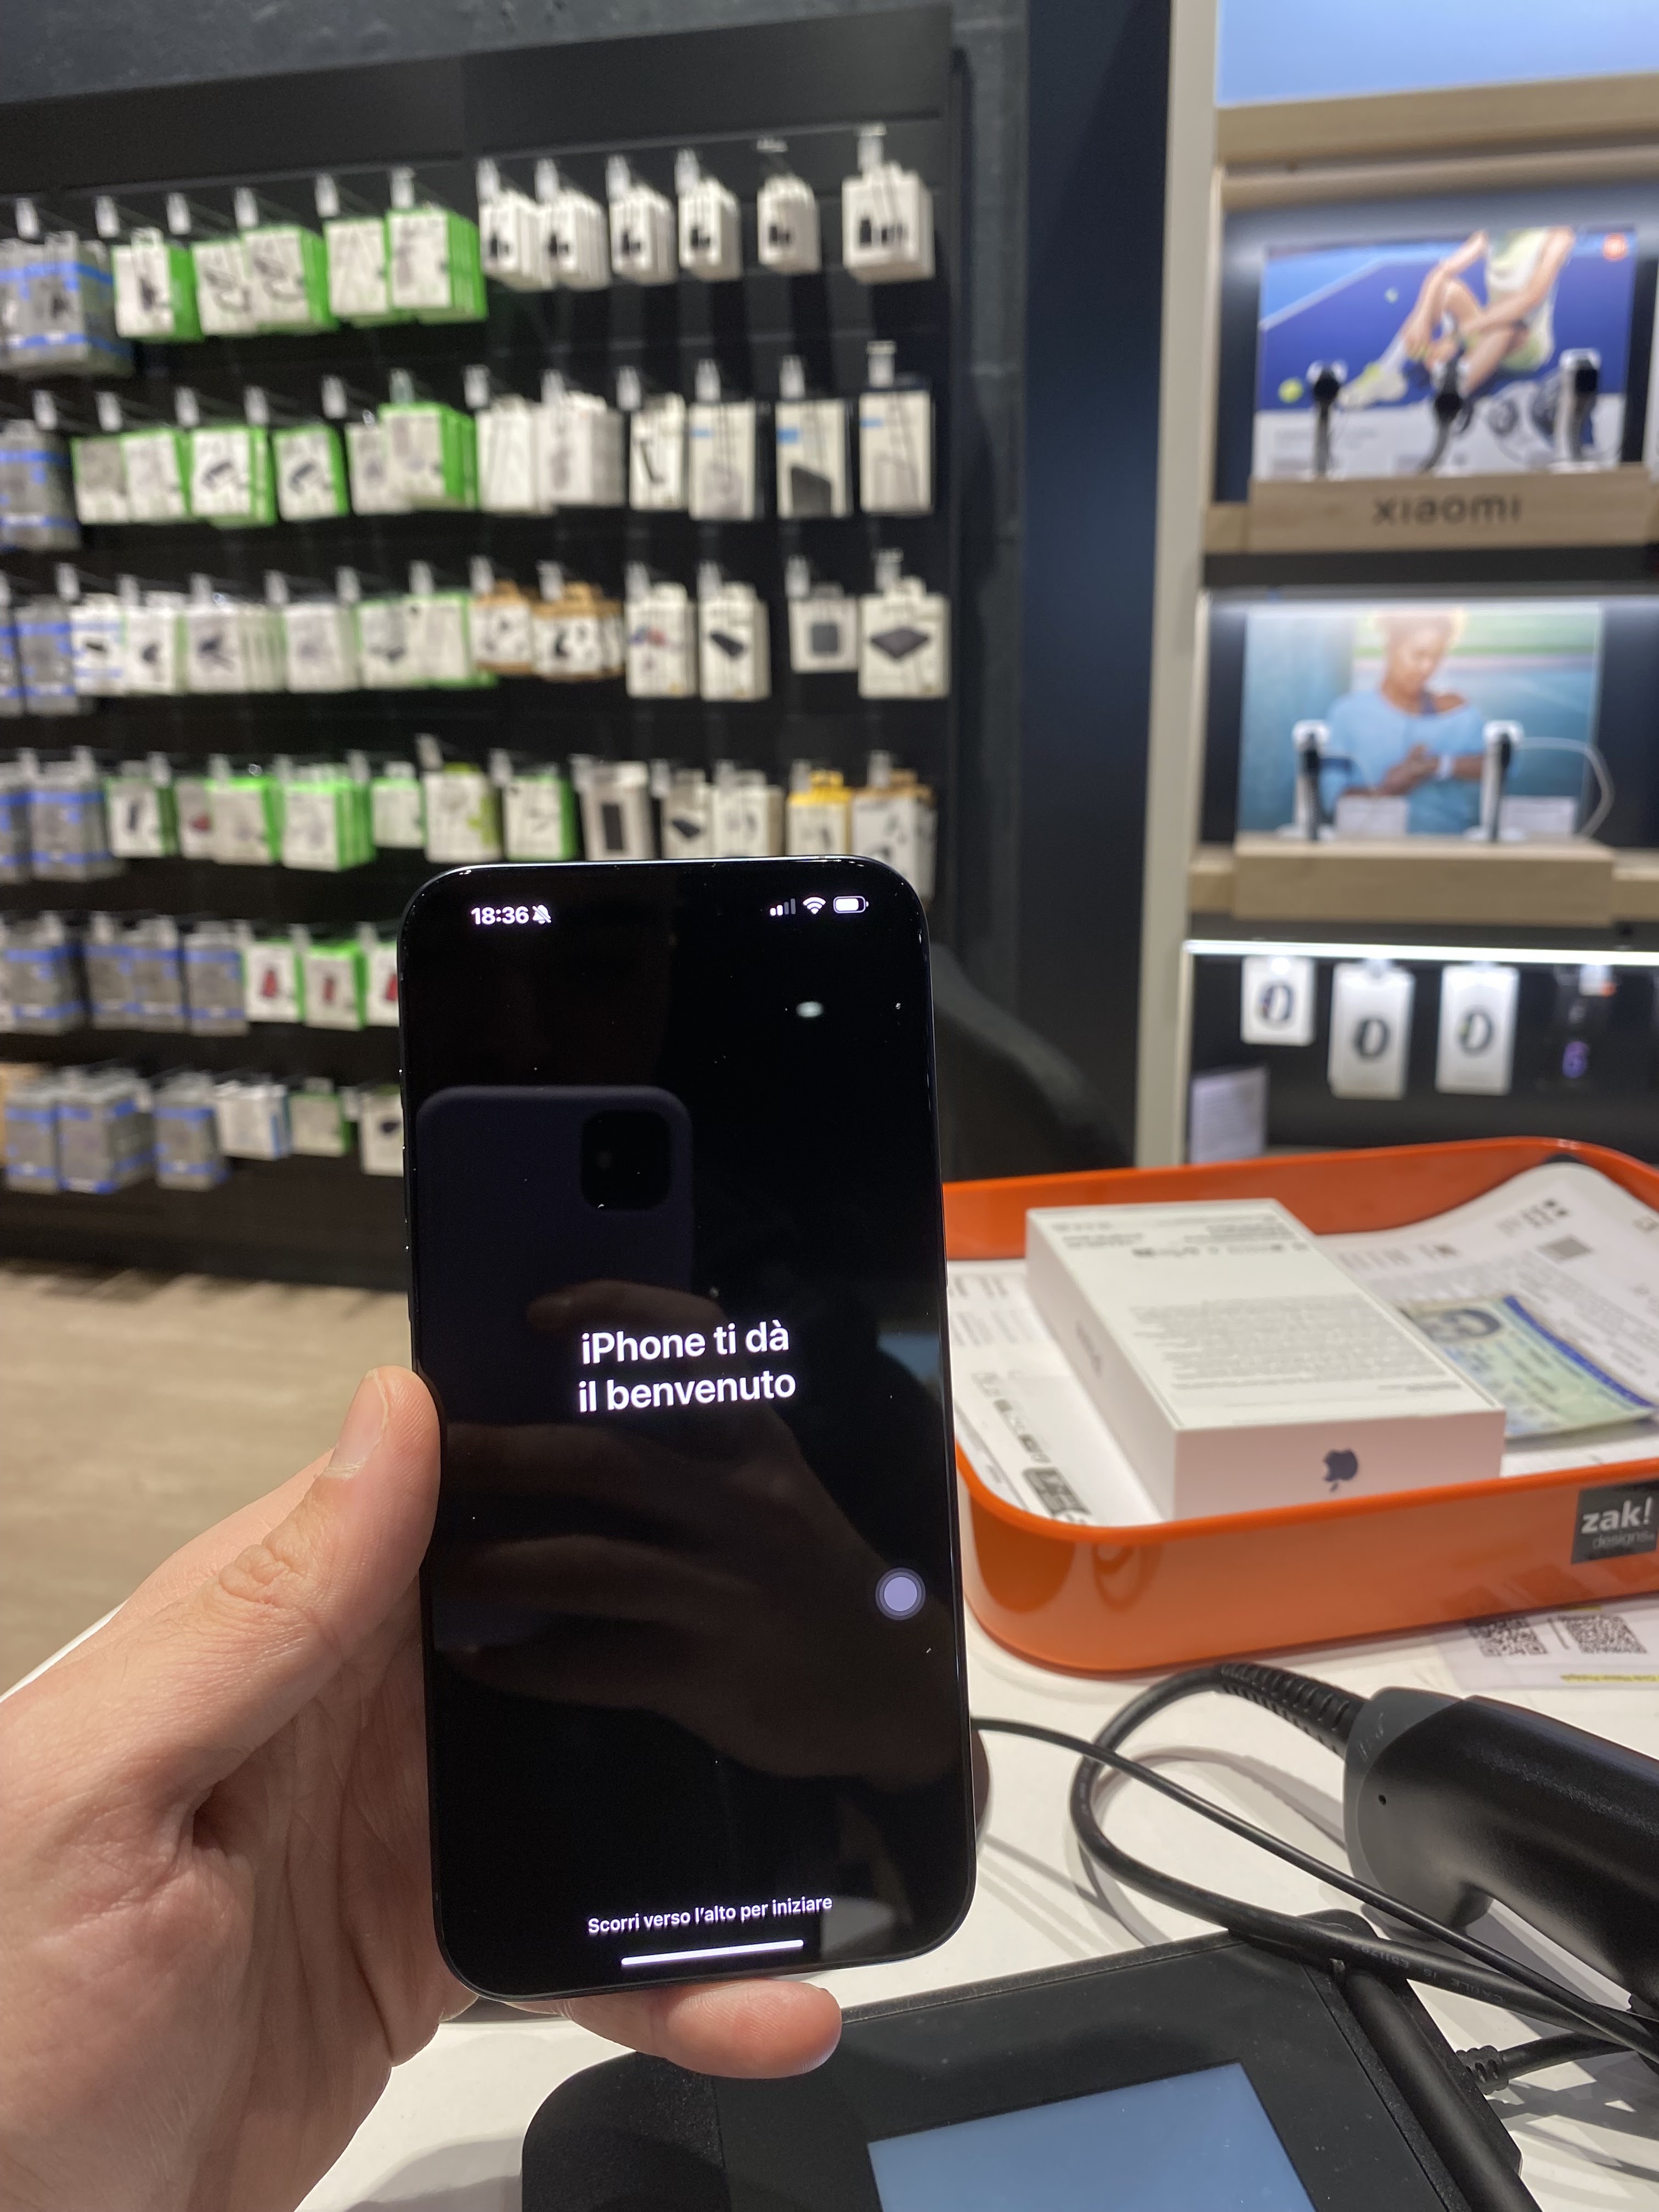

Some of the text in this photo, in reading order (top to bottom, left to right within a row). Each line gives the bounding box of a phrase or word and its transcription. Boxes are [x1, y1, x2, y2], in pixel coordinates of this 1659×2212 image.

[1373, 493, 1522, 524] xiaomi
[471, 906, 529, 925] 18:36
[581, 1319, 789, 1365] iPhone ti dà
[578, 1370, 796, 1413] il benvenuto
[1581, 1497, 1653, 1534] zak!
[588, 1913, 640, 1933] Scorri
[644, 1910, 691, 1928] verso
[740, 1903, 768, 1922] per
[771, 1896, 833, 1915] iniziare
